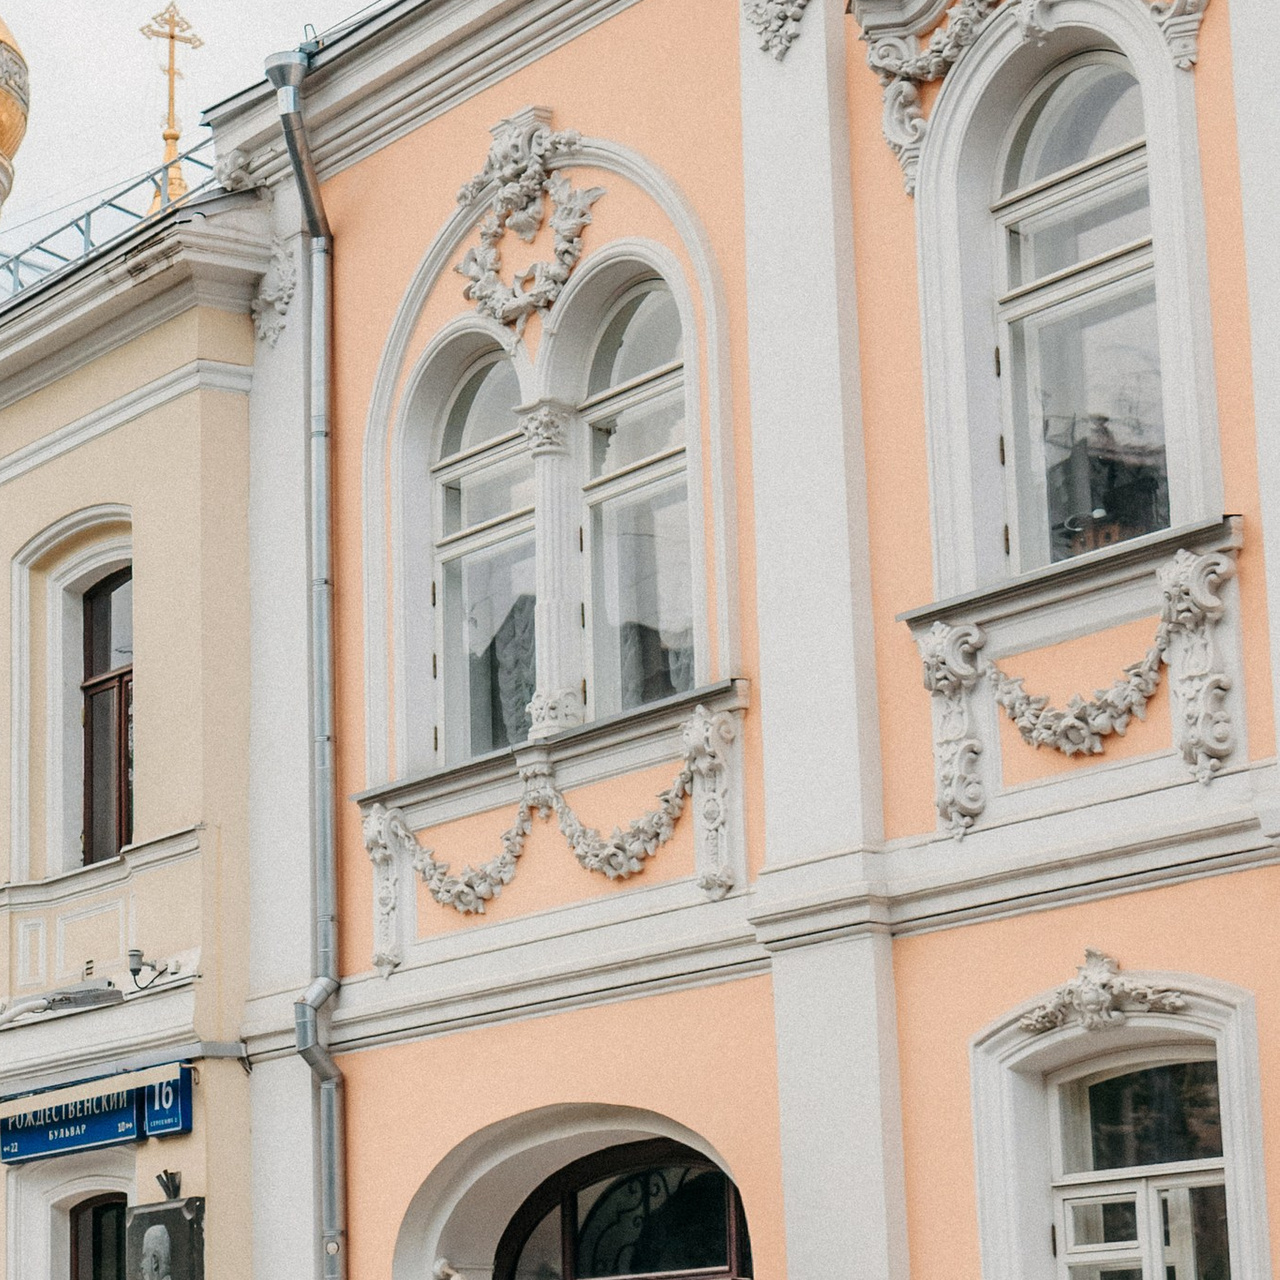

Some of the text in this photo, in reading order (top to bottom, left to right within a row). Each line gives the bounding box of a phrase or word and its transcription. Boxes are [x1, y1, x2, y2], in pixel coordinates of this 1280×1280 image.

[154, 1079, 173, 1111] 16
[48, 1124, 86, 1141] БУЛЬВАР
[10, 1142, 18, 1153] 22
